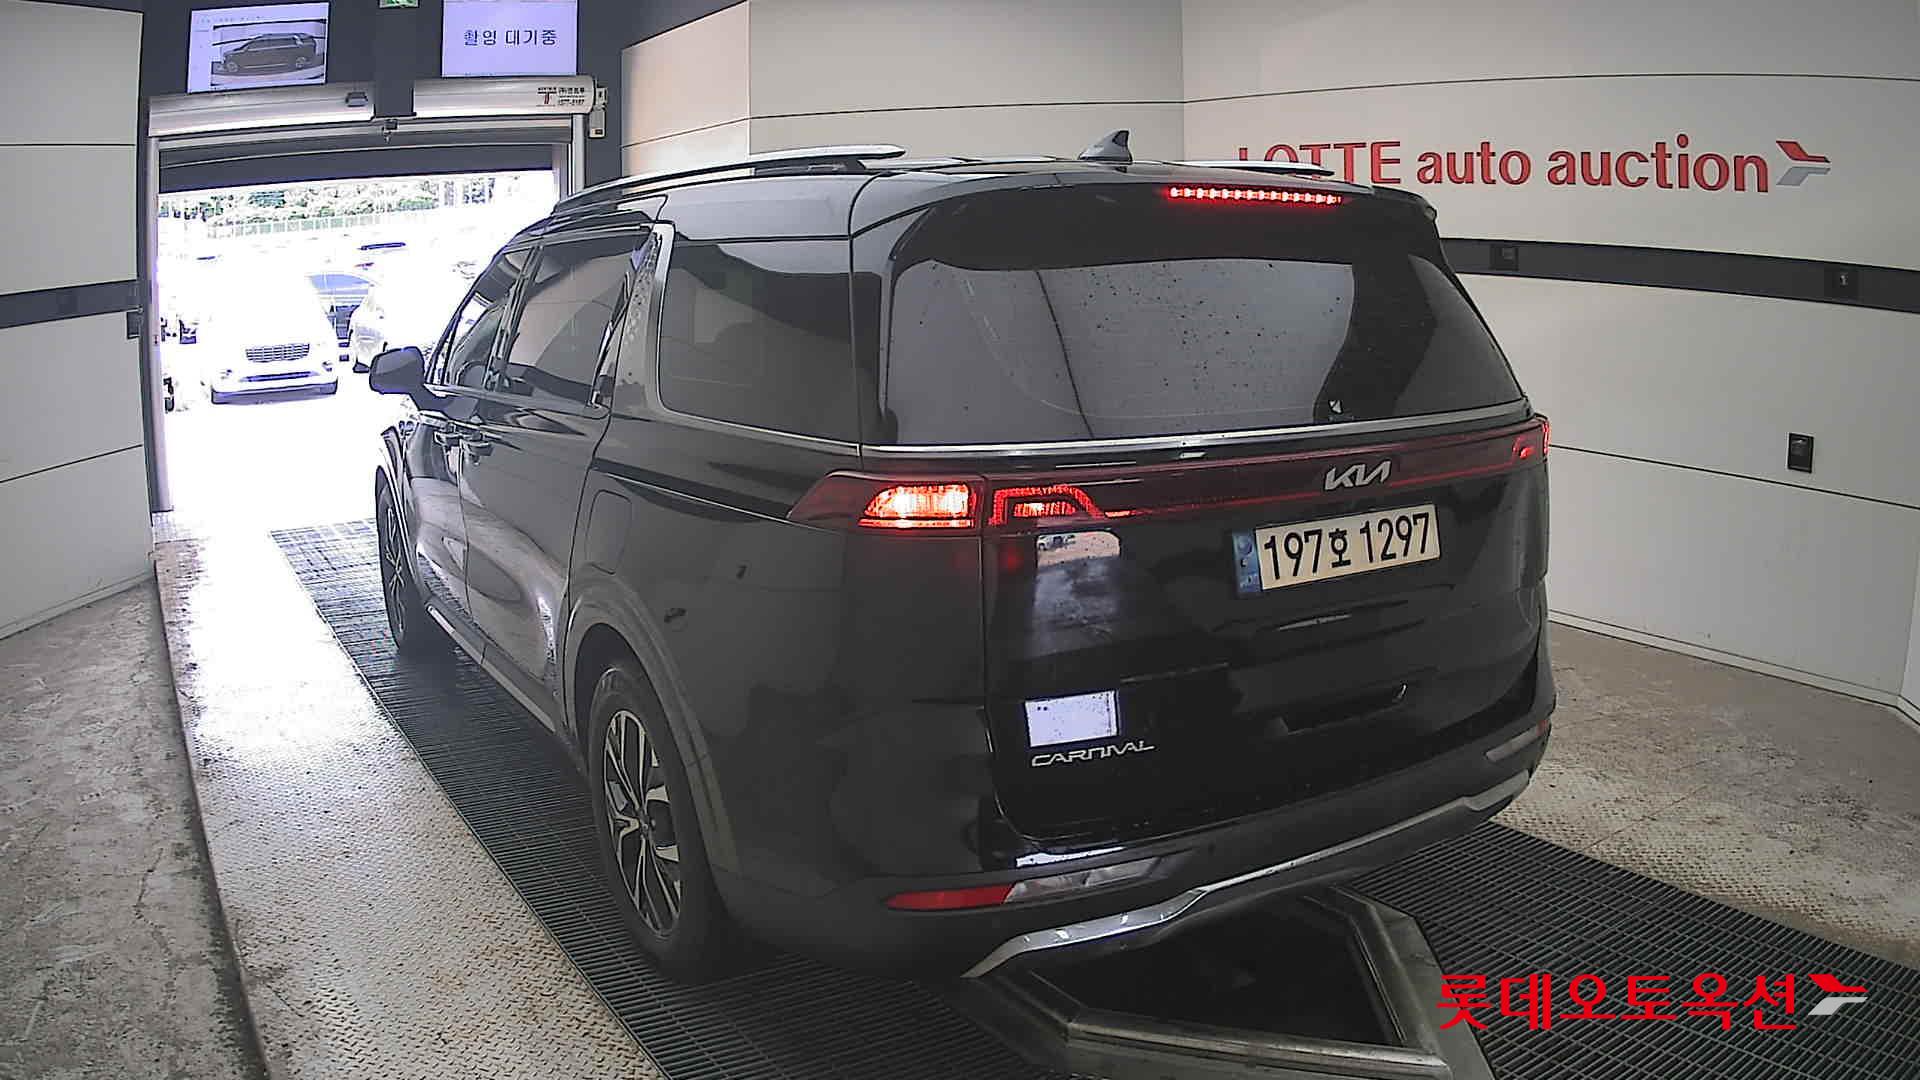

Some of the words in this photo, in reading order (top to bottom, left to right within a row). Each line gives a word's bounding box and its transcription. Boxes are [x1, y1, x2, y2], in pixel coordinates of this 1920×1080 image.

[504, 29, 558, 46] 대기중
[1238, 140, 1402, 184] TTE
[1416, 141, 1532, 185] auto
[1546, 133, 1770, 194] auction
[1324, 460, 1392, 491] KIA
[1263, 527, 1351, 580] 197호
[1359, 511, 1430, 564] 1297
[1031, 740, 1155, 767] CARNIVAL
